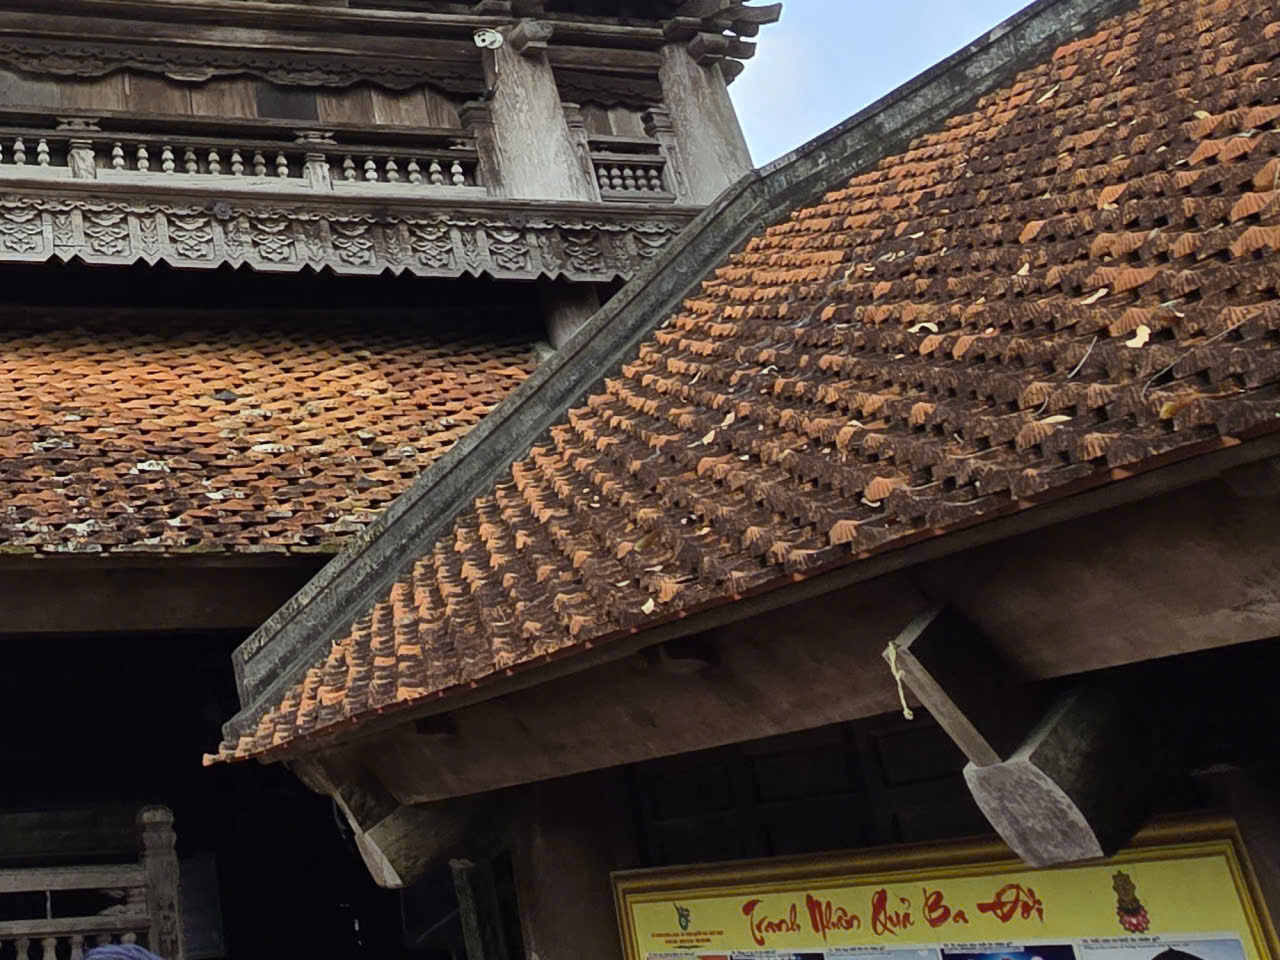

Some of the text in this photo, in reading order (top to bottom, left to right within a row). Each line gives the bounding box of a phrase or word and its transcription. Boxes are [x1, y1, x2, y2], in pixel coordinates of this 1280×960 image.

[742, 883, 1044, 946] Tranh Nhân Quả Ba Đời
